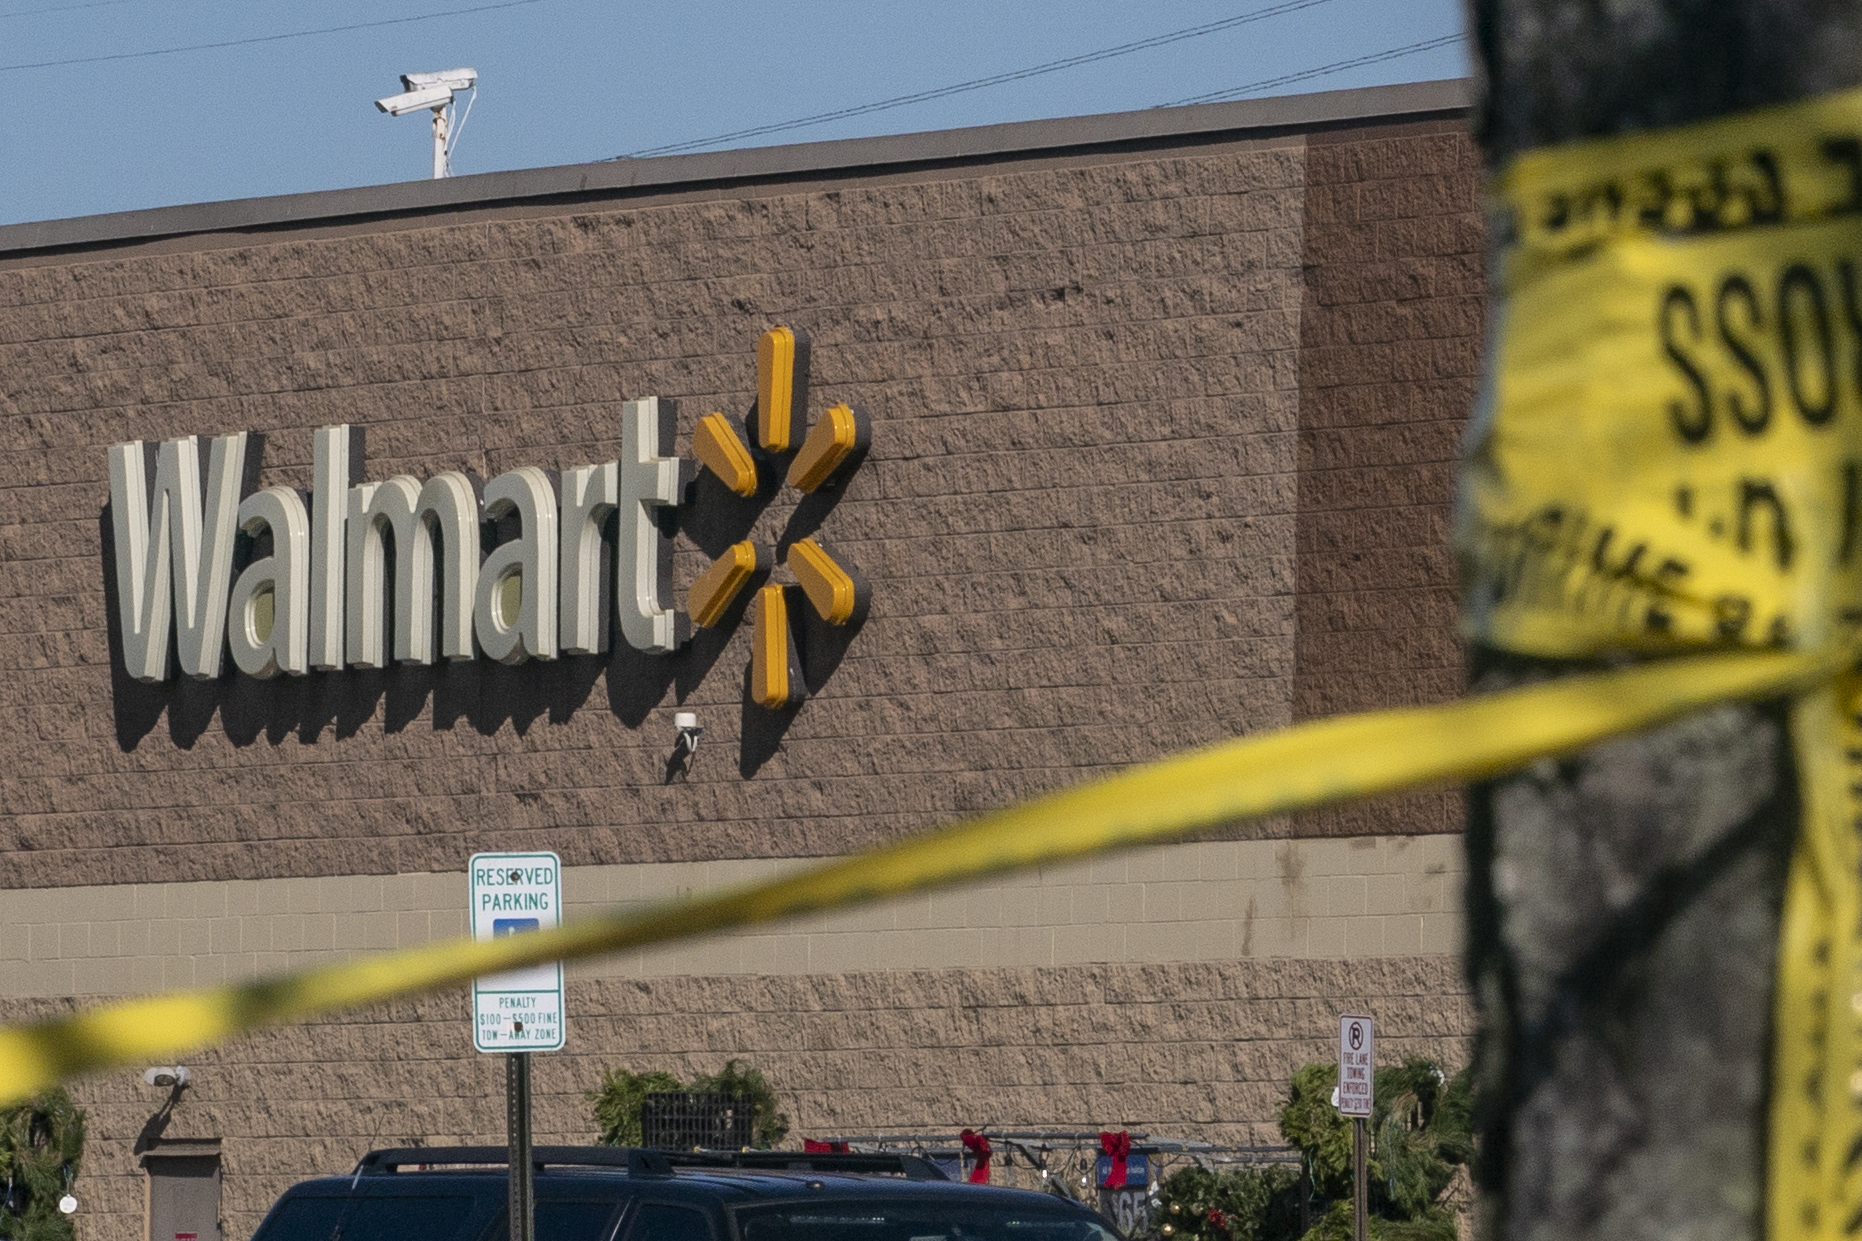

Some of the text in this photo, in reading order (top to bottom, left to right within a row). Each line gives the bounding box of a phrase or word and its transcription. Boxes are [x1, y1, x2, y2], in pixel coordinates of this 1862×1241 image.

[108, 396, 679, 681] Walmart
[476, 867, 553, 886] RESERVED
[482, 892, 549, 911] PARKING
[499, 997, 536, 1009] PENALTY
[538, 1012, 558, 1024] FINE
[534, 1028, 556, 1040] ZONE
[1343, 1052, 1368, 1066] FIRE LANE
[1347, 1067, 1365, 1080] TOWING
[1343, 1082, 1368, 1095] ENFORCED
